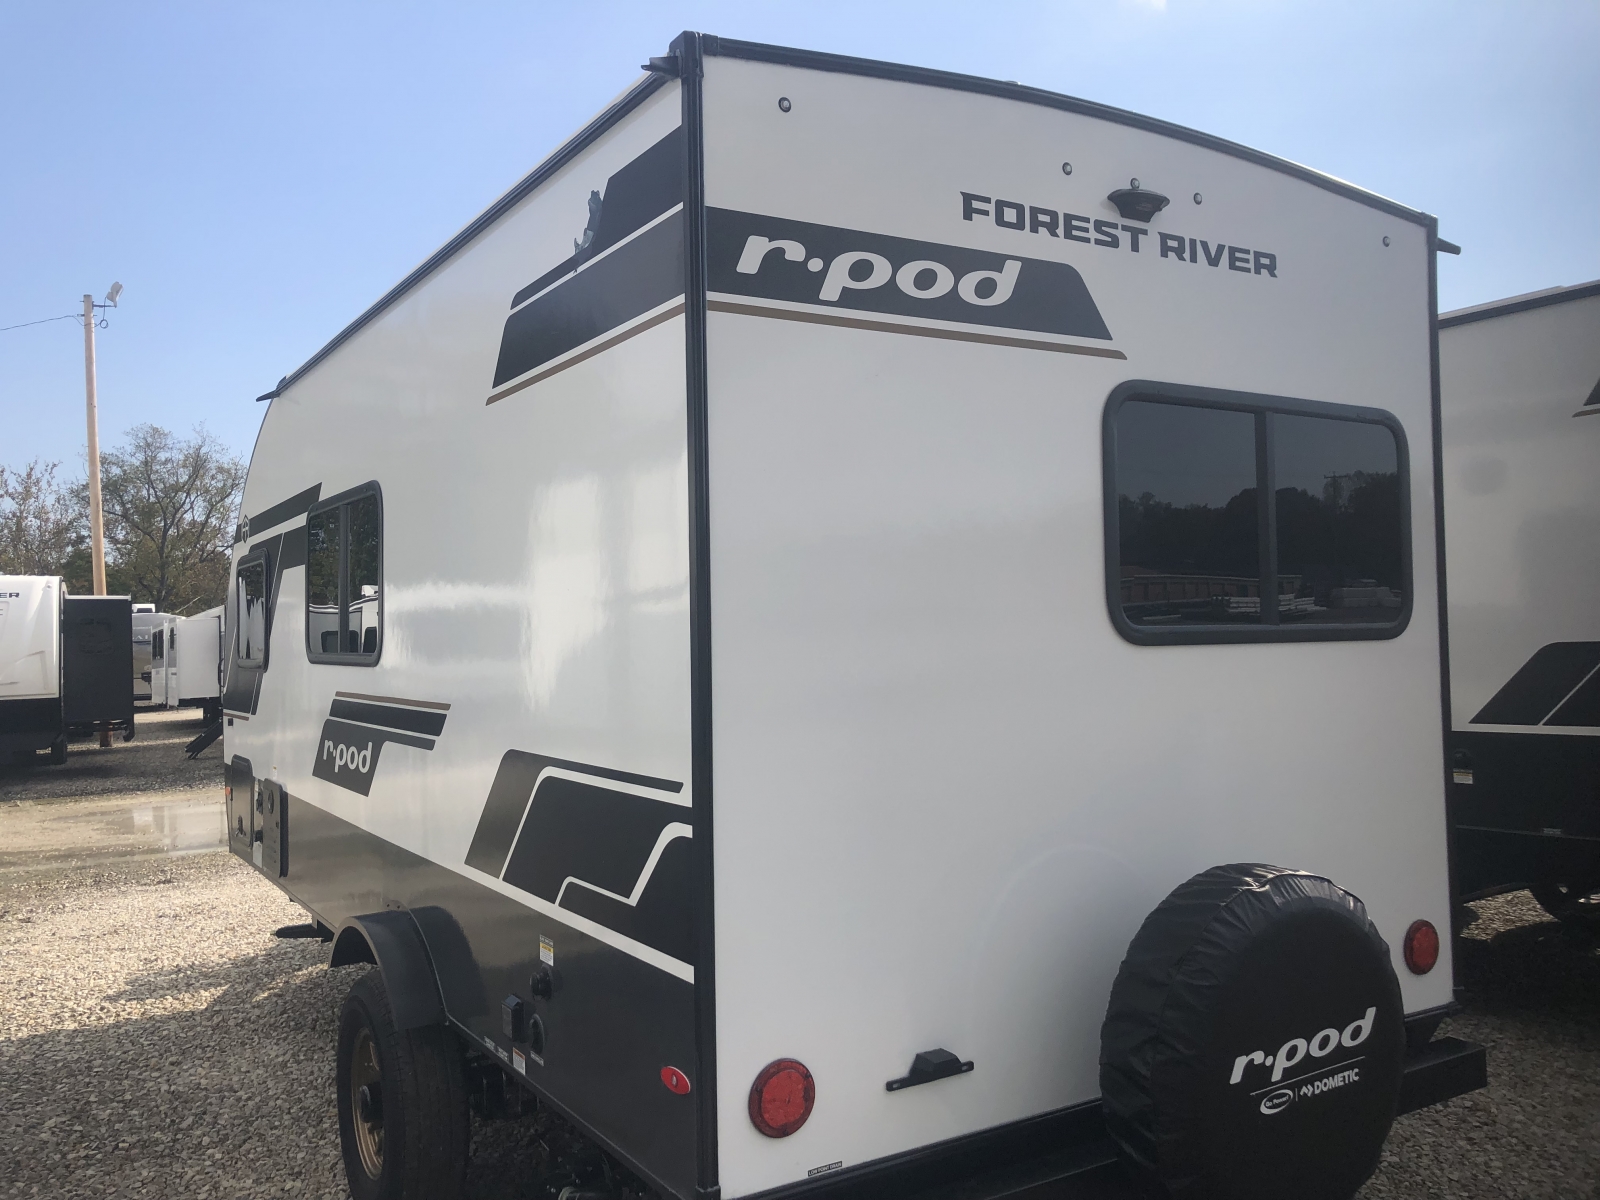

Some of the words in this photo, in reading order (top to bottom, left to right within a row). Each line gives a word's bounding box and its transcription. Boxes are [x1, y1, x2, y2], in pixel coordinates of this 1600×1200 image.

[960, 191, 1148, 253] FOREST
[1158, 231, 1278, 278] RIVER
[1314, 1068, 1360, 1094] DOMETIC
